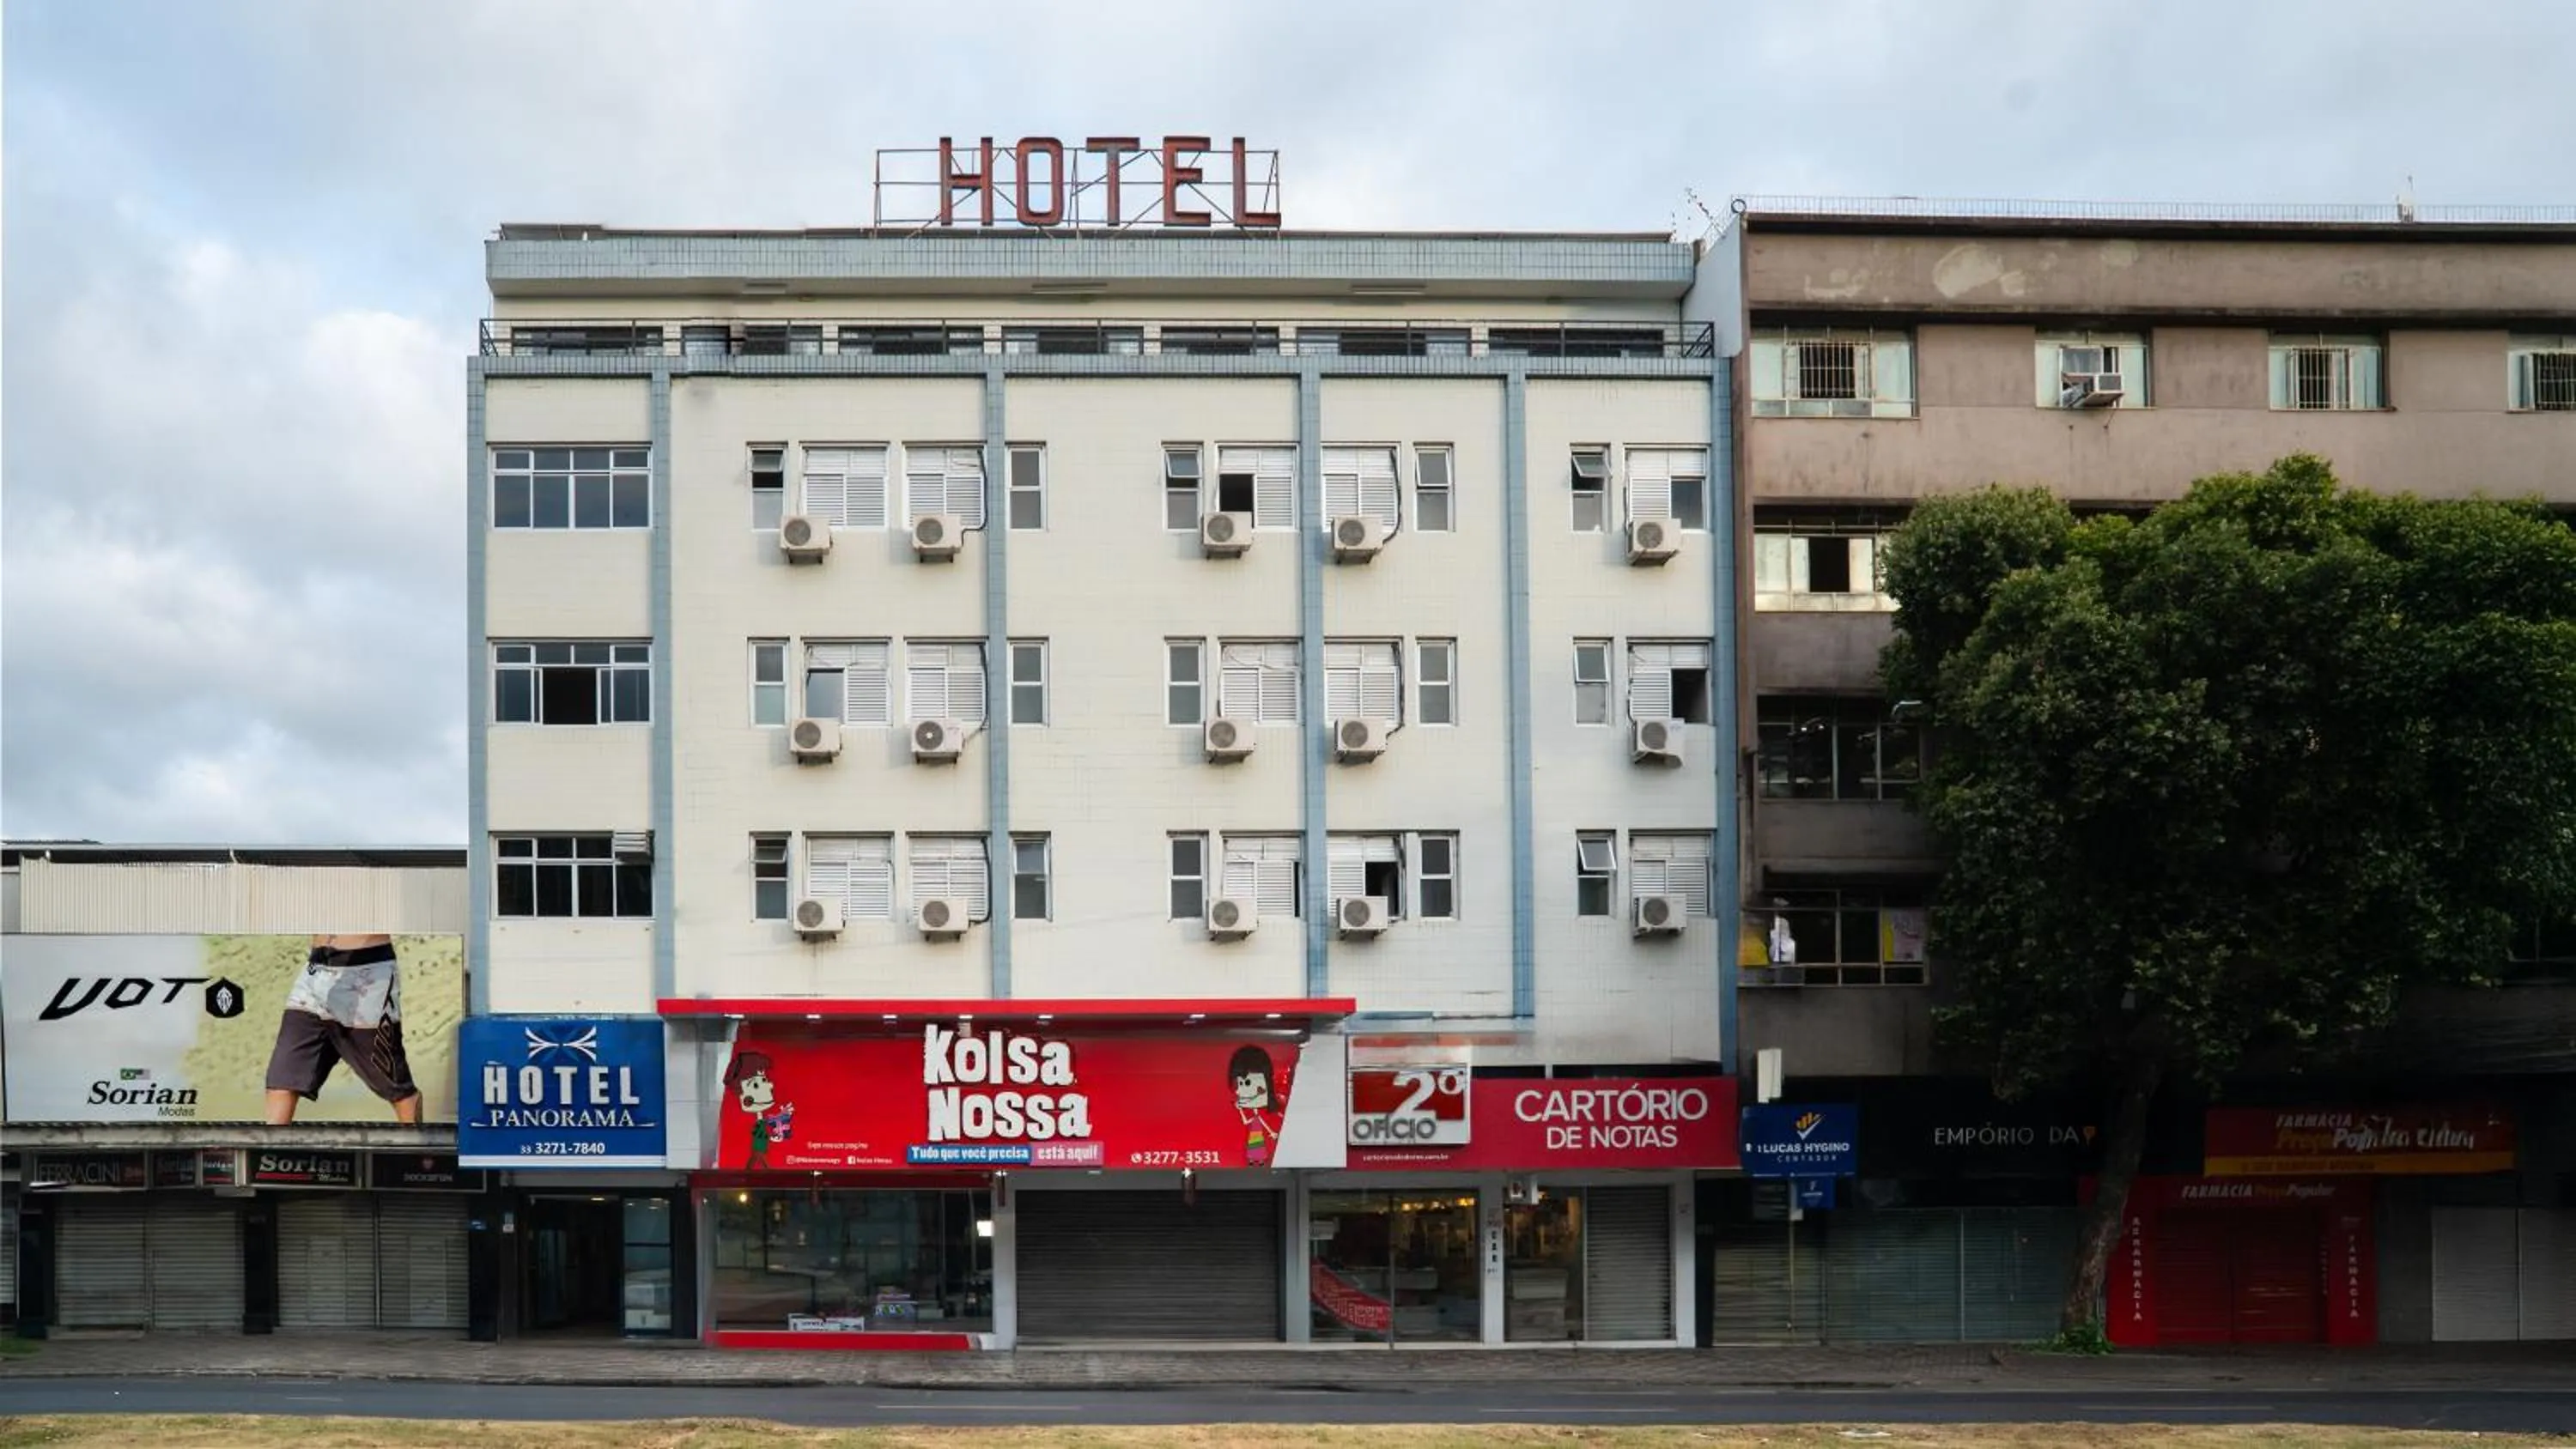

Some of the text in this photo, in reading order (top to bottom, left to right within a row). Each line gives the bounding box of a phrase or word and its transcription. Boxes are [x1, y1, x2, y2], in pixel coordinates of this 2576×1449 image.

[939, 136, 1281, 227] HOTEL
[87, 1080, 198, 1105] Sorian
[483, 1064, 641, 1106] HOTEL
[157, 1106, 196, 1117] Modas
[927, 1087, 1093, 1142] Nossa
[1514, 1083, 1709, 1124] CARTÓRIO
[489, 1109, 635, 1129] PANORAMA
[1546, 1125, 1679, 1150] DE NOTAS
[1934, 1121, 2080, 1146] EMPÓRIO DA
[535, 1142, 606, 1155] 3271-7840
[911, 1146, 940, 1159] Tudo
[940, 1149, 959, 1162] que
[961, 1146, 987, 1159] você
[1037, 1146, 1066, 1160] está
[1143, 1150, 1220, 1164] 3277-3531
[1763, 1142, 1850, 1154] LUCAS HYGINO
[39, 1161, 121, 1183] FERRACINI
[259, 1154, 350, 1173] Sorian
